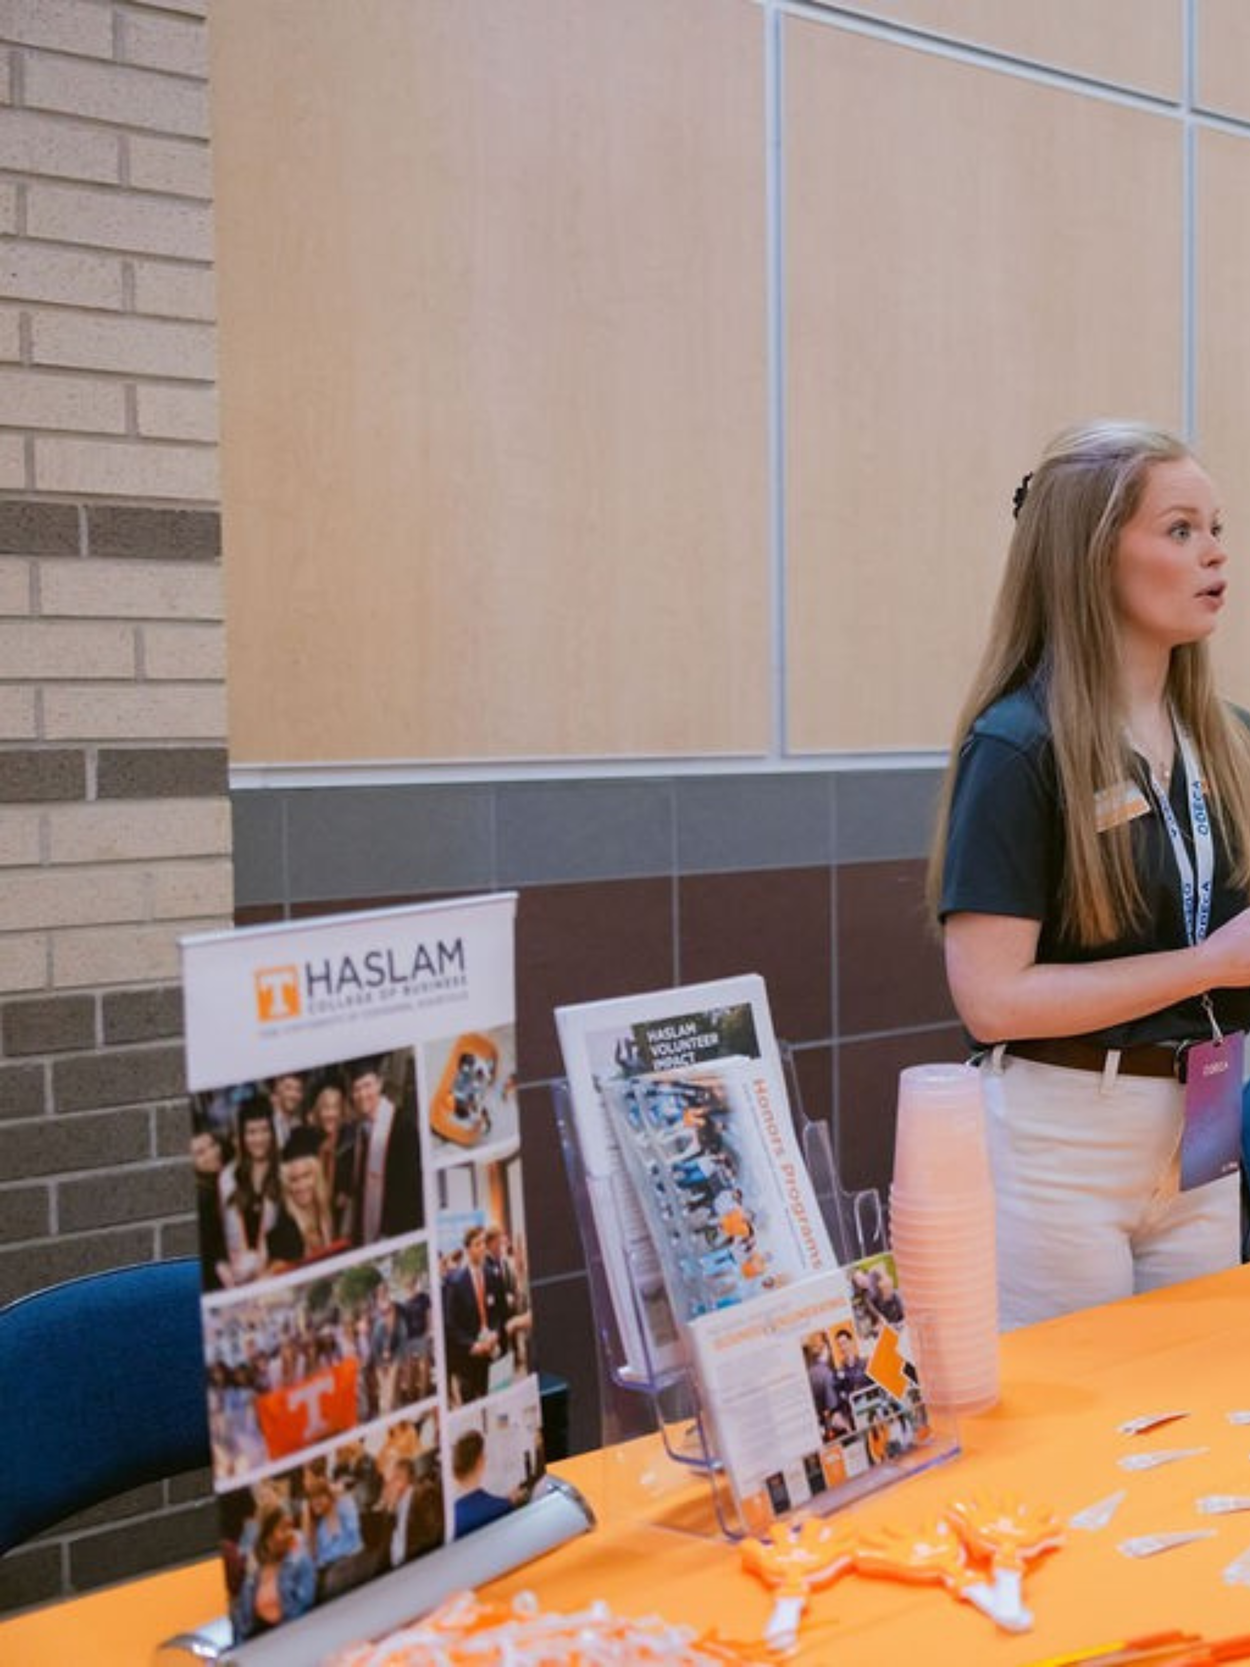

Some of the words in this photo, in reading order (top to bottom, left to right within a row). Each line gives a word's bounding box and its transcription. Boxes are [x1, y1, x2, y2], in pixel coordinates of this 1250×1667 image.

[305, 937, 464, 996] HASLAM
[647, 1022, 697, 1042] HASLAM
[651, 1033, 719, 1057] VOLUNTEER
[654, 1053, 696, 1071] IMPACT
[752, 1078, 784, 1156] Honors
[780, 1162, 822, 1269] Programs
